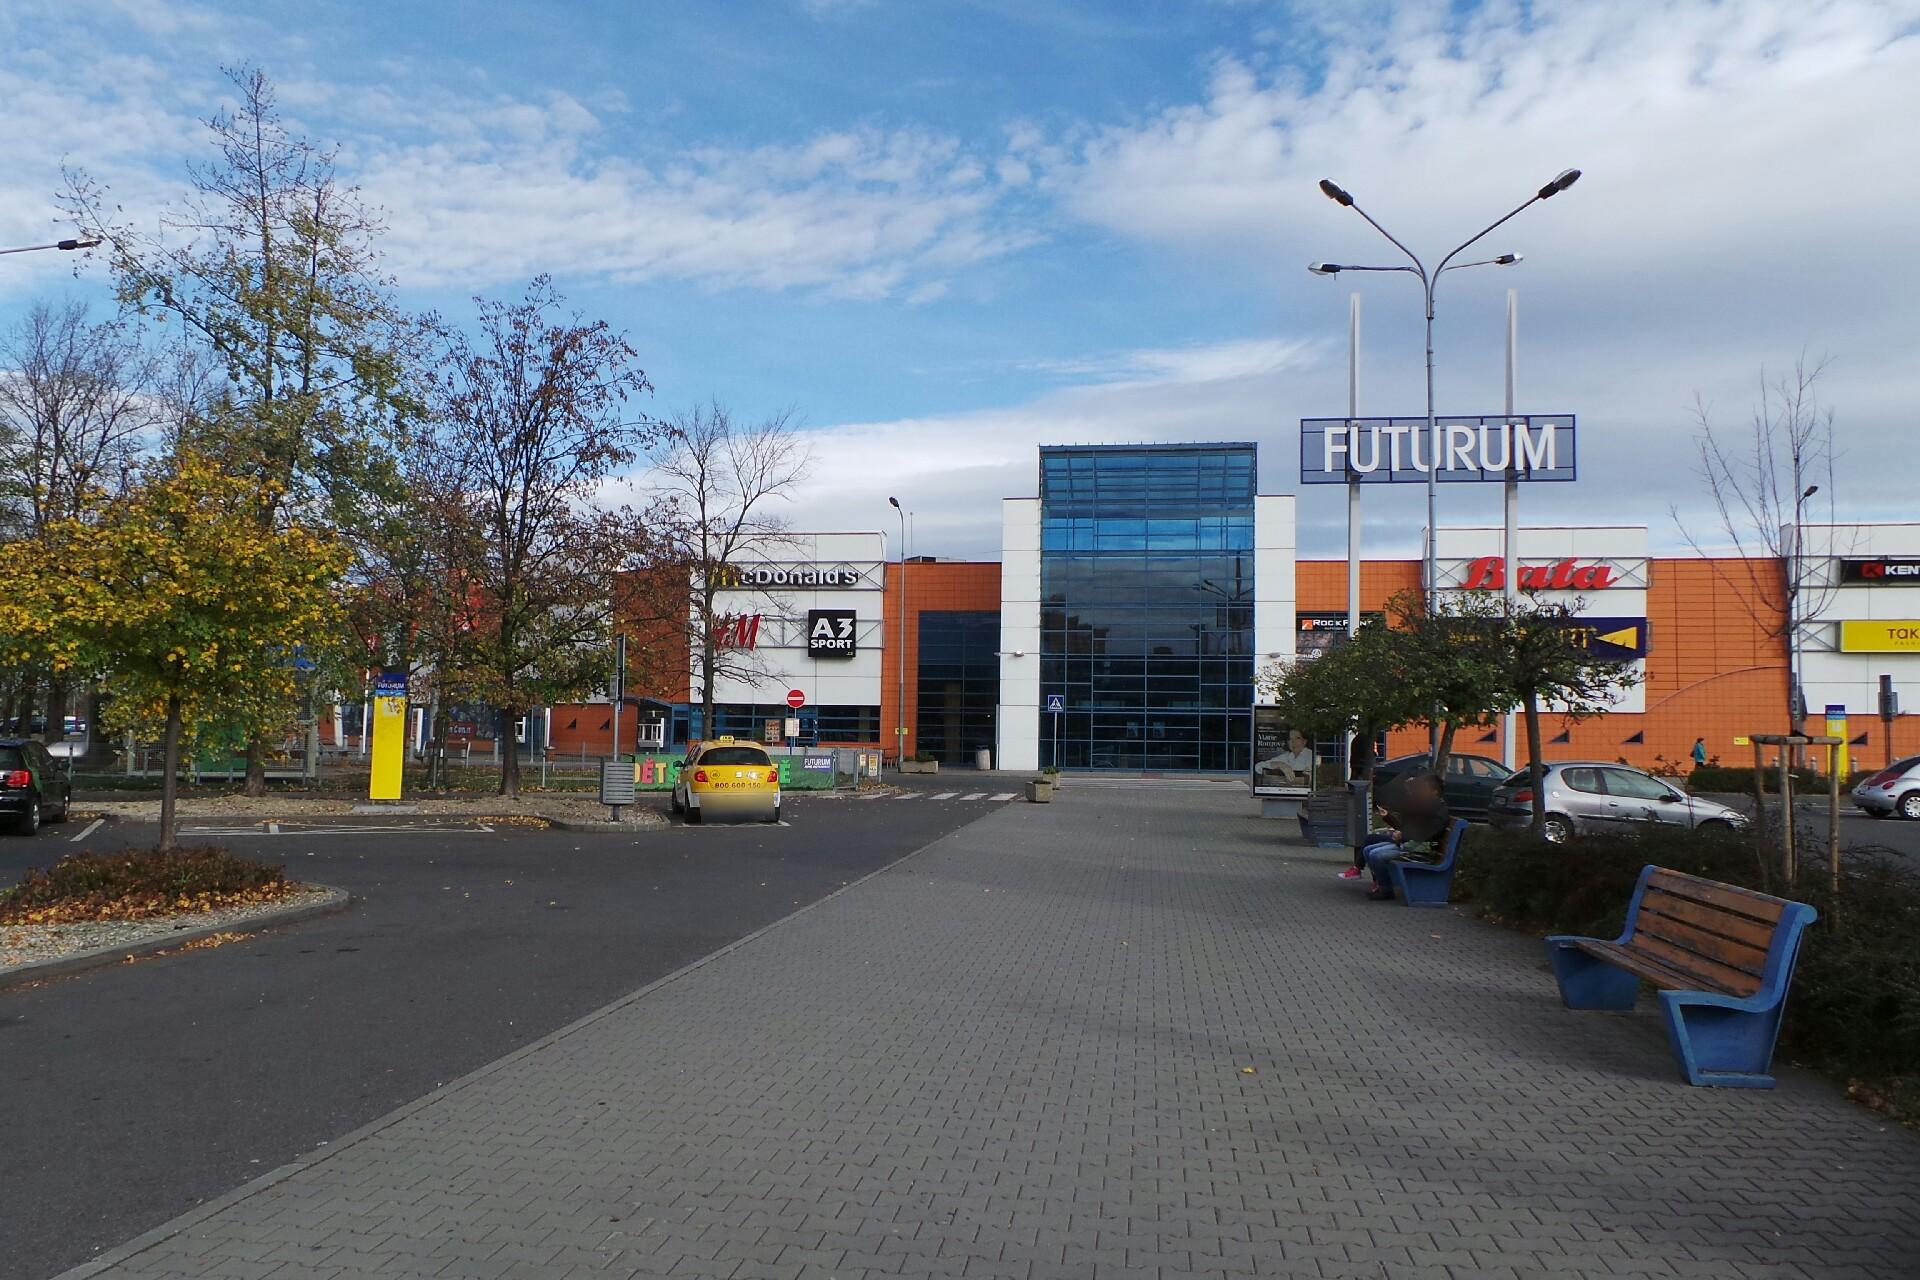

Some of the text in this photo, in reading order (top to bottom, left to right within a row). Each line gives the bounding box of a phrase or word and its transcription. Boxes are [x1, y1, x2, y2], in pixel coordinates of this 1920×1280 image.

[1324, 424, 1556, 472] FUTURUM
[1885, 565, 1920, 575] KEN
[810, 639, 853, 649] SPORT
[804, 758, 831, 766] FUTURUM
